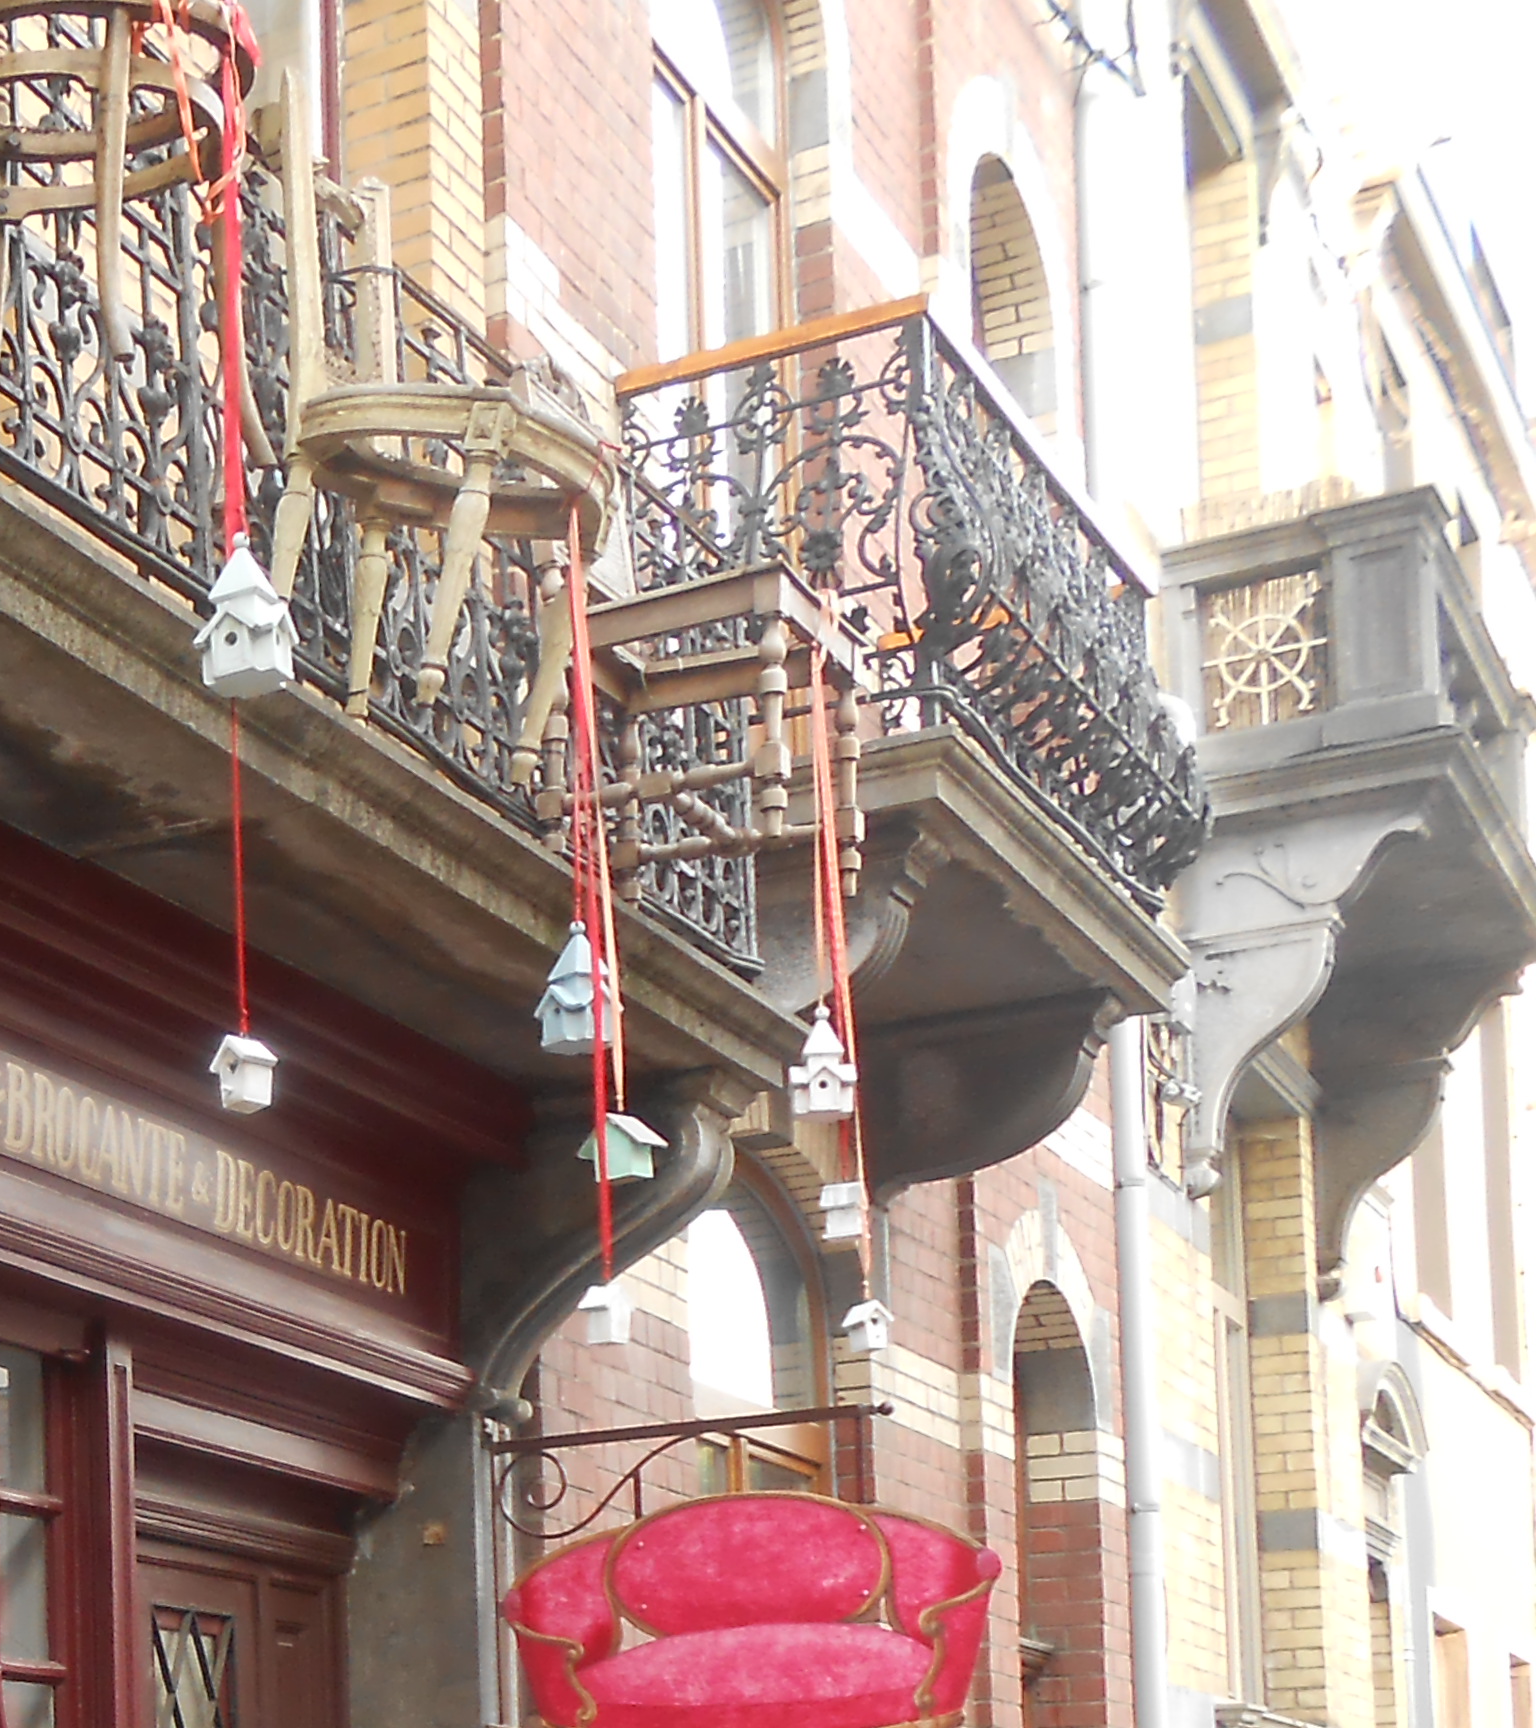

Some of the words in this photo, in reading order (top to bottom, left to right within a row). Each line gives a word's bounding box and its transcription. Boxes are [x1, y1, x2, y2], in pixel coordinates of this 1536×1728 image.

[3, 1061, 188, 1218] BROCANTE
[190, 1160, 211, 1206] &
[213, 1149, 407, 1296] DECORATION
